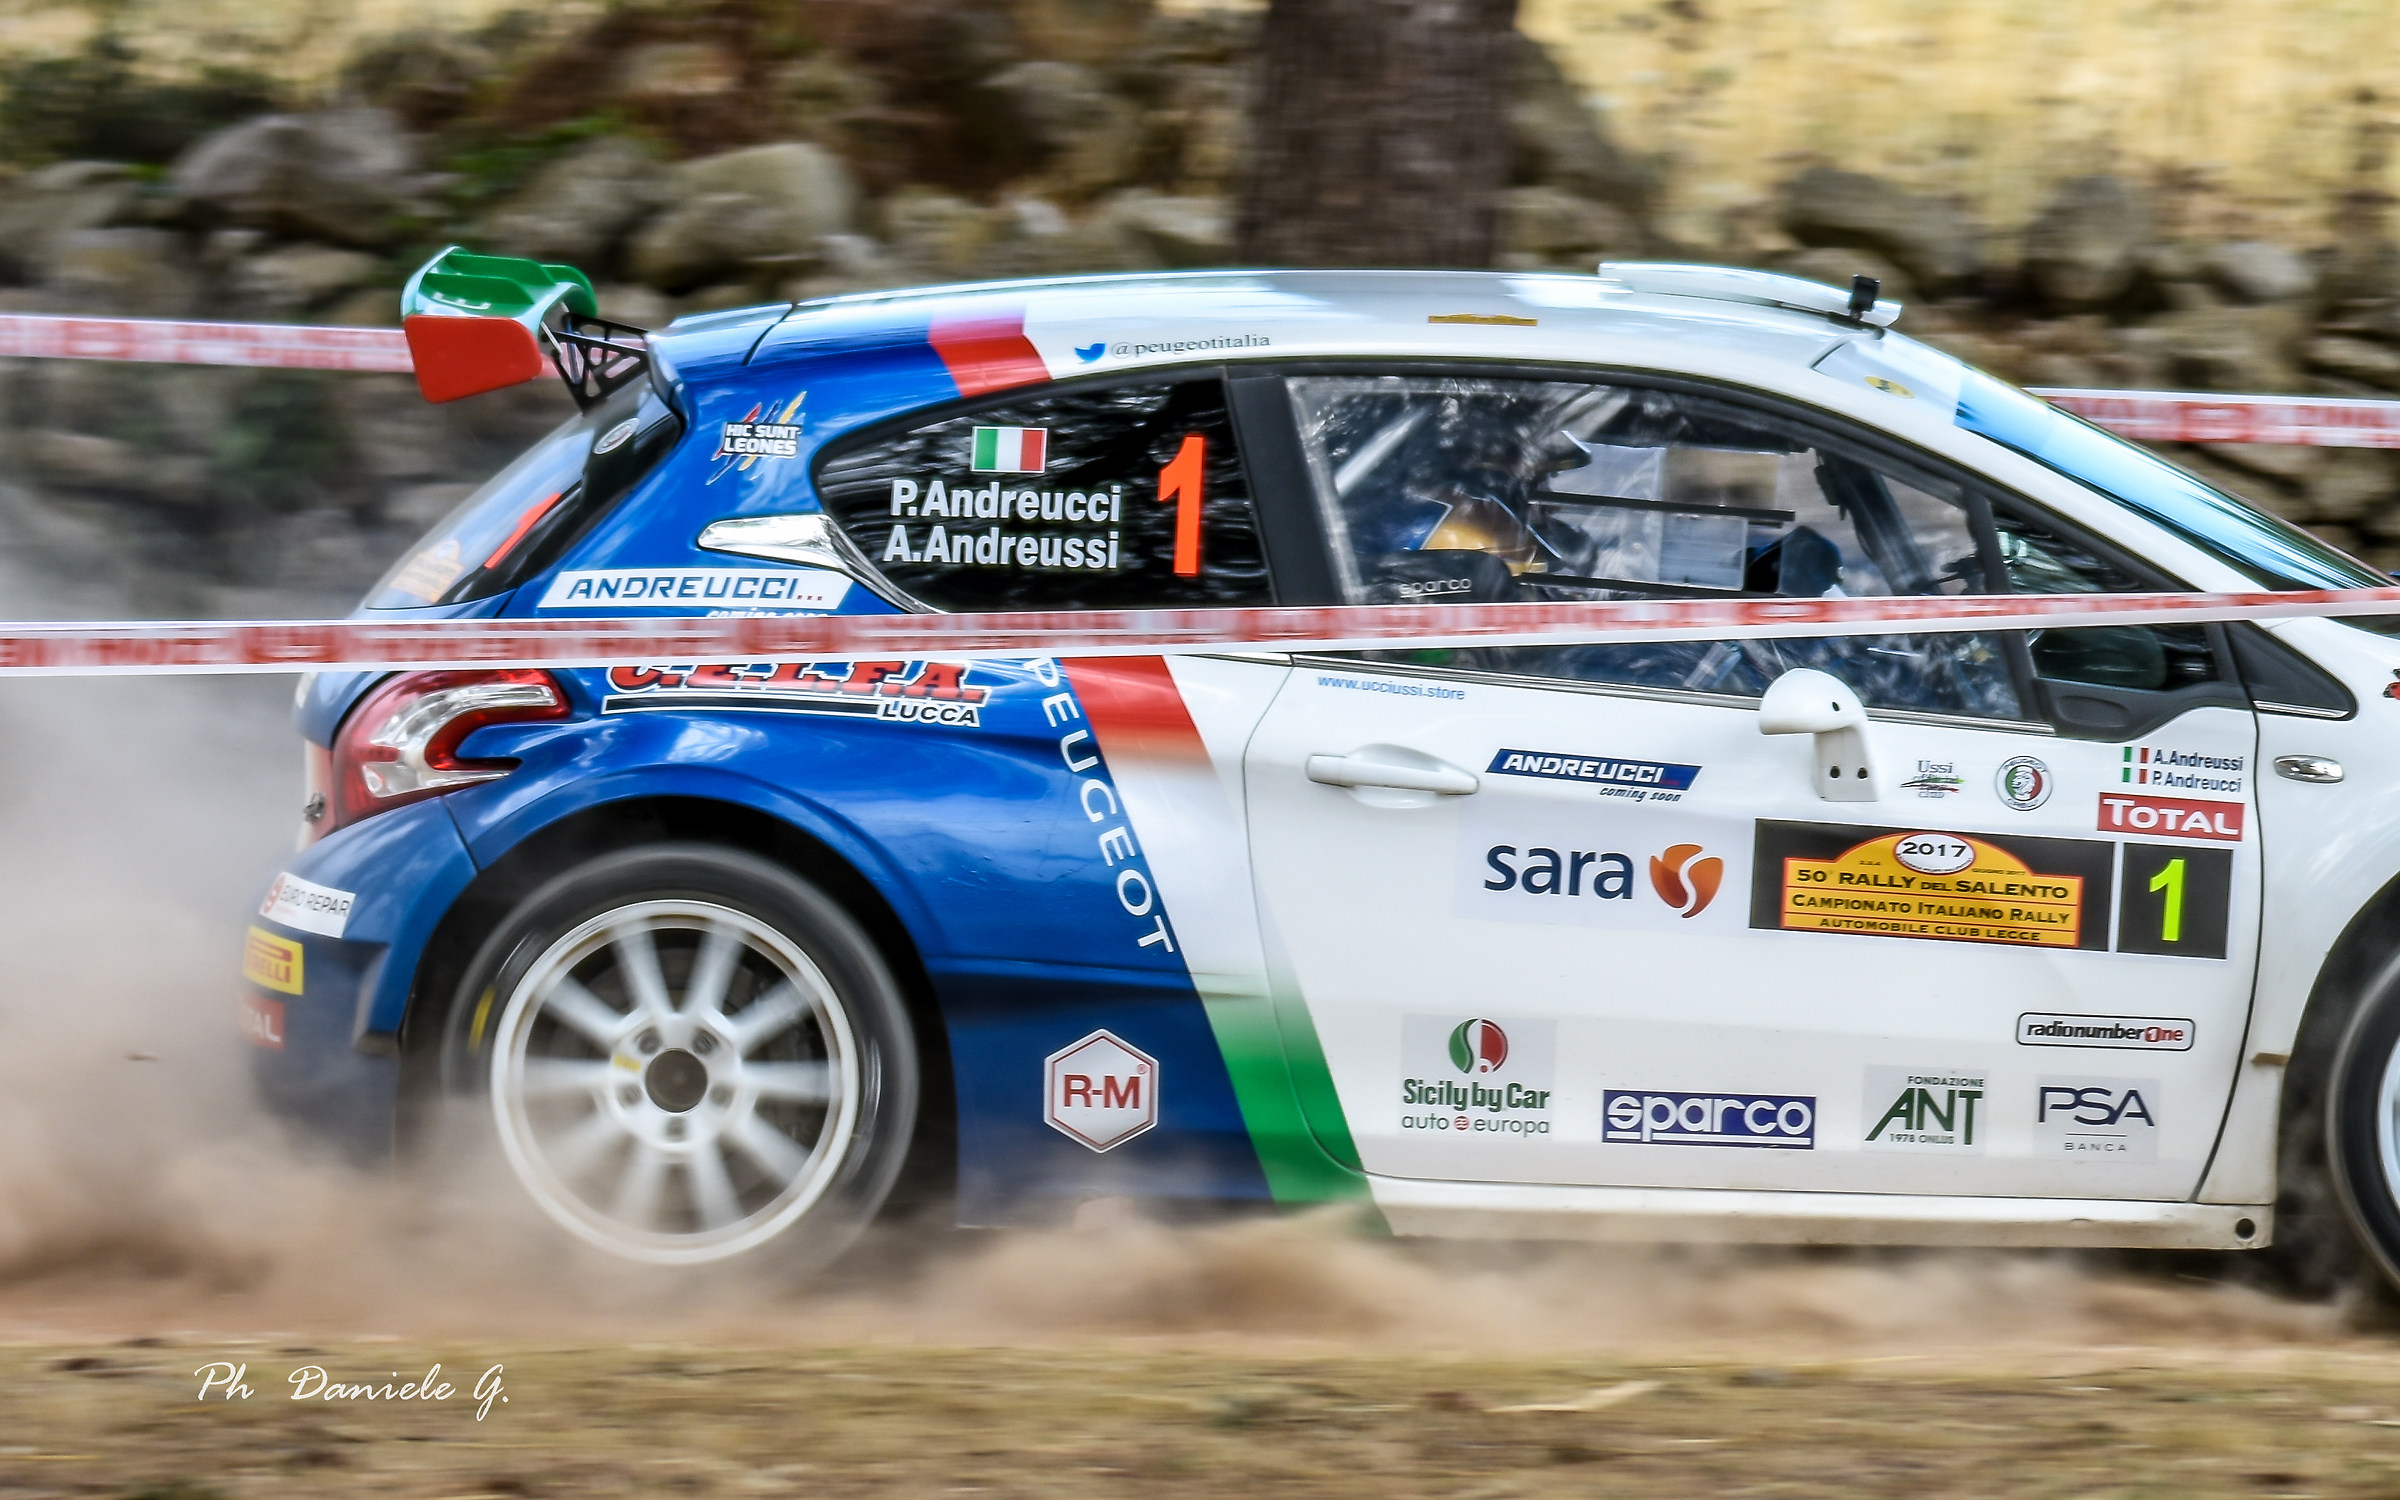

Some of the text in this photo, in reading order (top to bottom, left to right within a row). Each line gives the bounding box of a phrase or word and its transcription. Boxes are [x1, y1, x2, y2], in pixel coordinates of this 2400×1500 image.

[1111, 334, 1270, 359] @peugeotitalia
[726, 424, 800, 439] HIC SUNT
[724, 437, 798, 455] LEONES
[890, 479, 1121, 522] P.Andreucci
[1158, 435, 1204, 575] 1
[882, 524, 1119, 568] A.Andreussi
[1317, 676, 1465, 700] www.ucciussi.store
[881, 703, 977, 725] LUCCA
[1917, 760, 1954, 774] Ussi
[1024, 657, 1174, 953] PEUGEOT
[1599, 787, 1682, 802] coming soon
[2103, 798, 2240, 835] TOTAL
[1902, 842, 1967, 858] 2017
[1484, 844, 1634, 900] sara
[1839, 871, 1917, 890] RALLY
[1921, 881, 1952, 892] DEL
[1956, 879, 2069, 900] SALENTO
[307, 892, 349, 916] REPAR
[1792, 893, 2070, 924] CAMPIONATO ITALIANO RALLY
[2149, 858, 2185, 942] 1
[1819, 918, 2041, 941] AUTOMOBILE CLUB LECCE
[1907, 1075, 1984, 1088] FONDAZIONE
[1403, 1078, 1551, 1113] Sicily by Car
[2038, 1086, 2155, 1127] PSA
[1402, 1113, 1550, 1138] auto europa
[1607, 1095, 1812, 1143] sparco
[1864, 1088, 1983, 1145] ANT
[2064, 1142, 2128, 1152] BANCA
